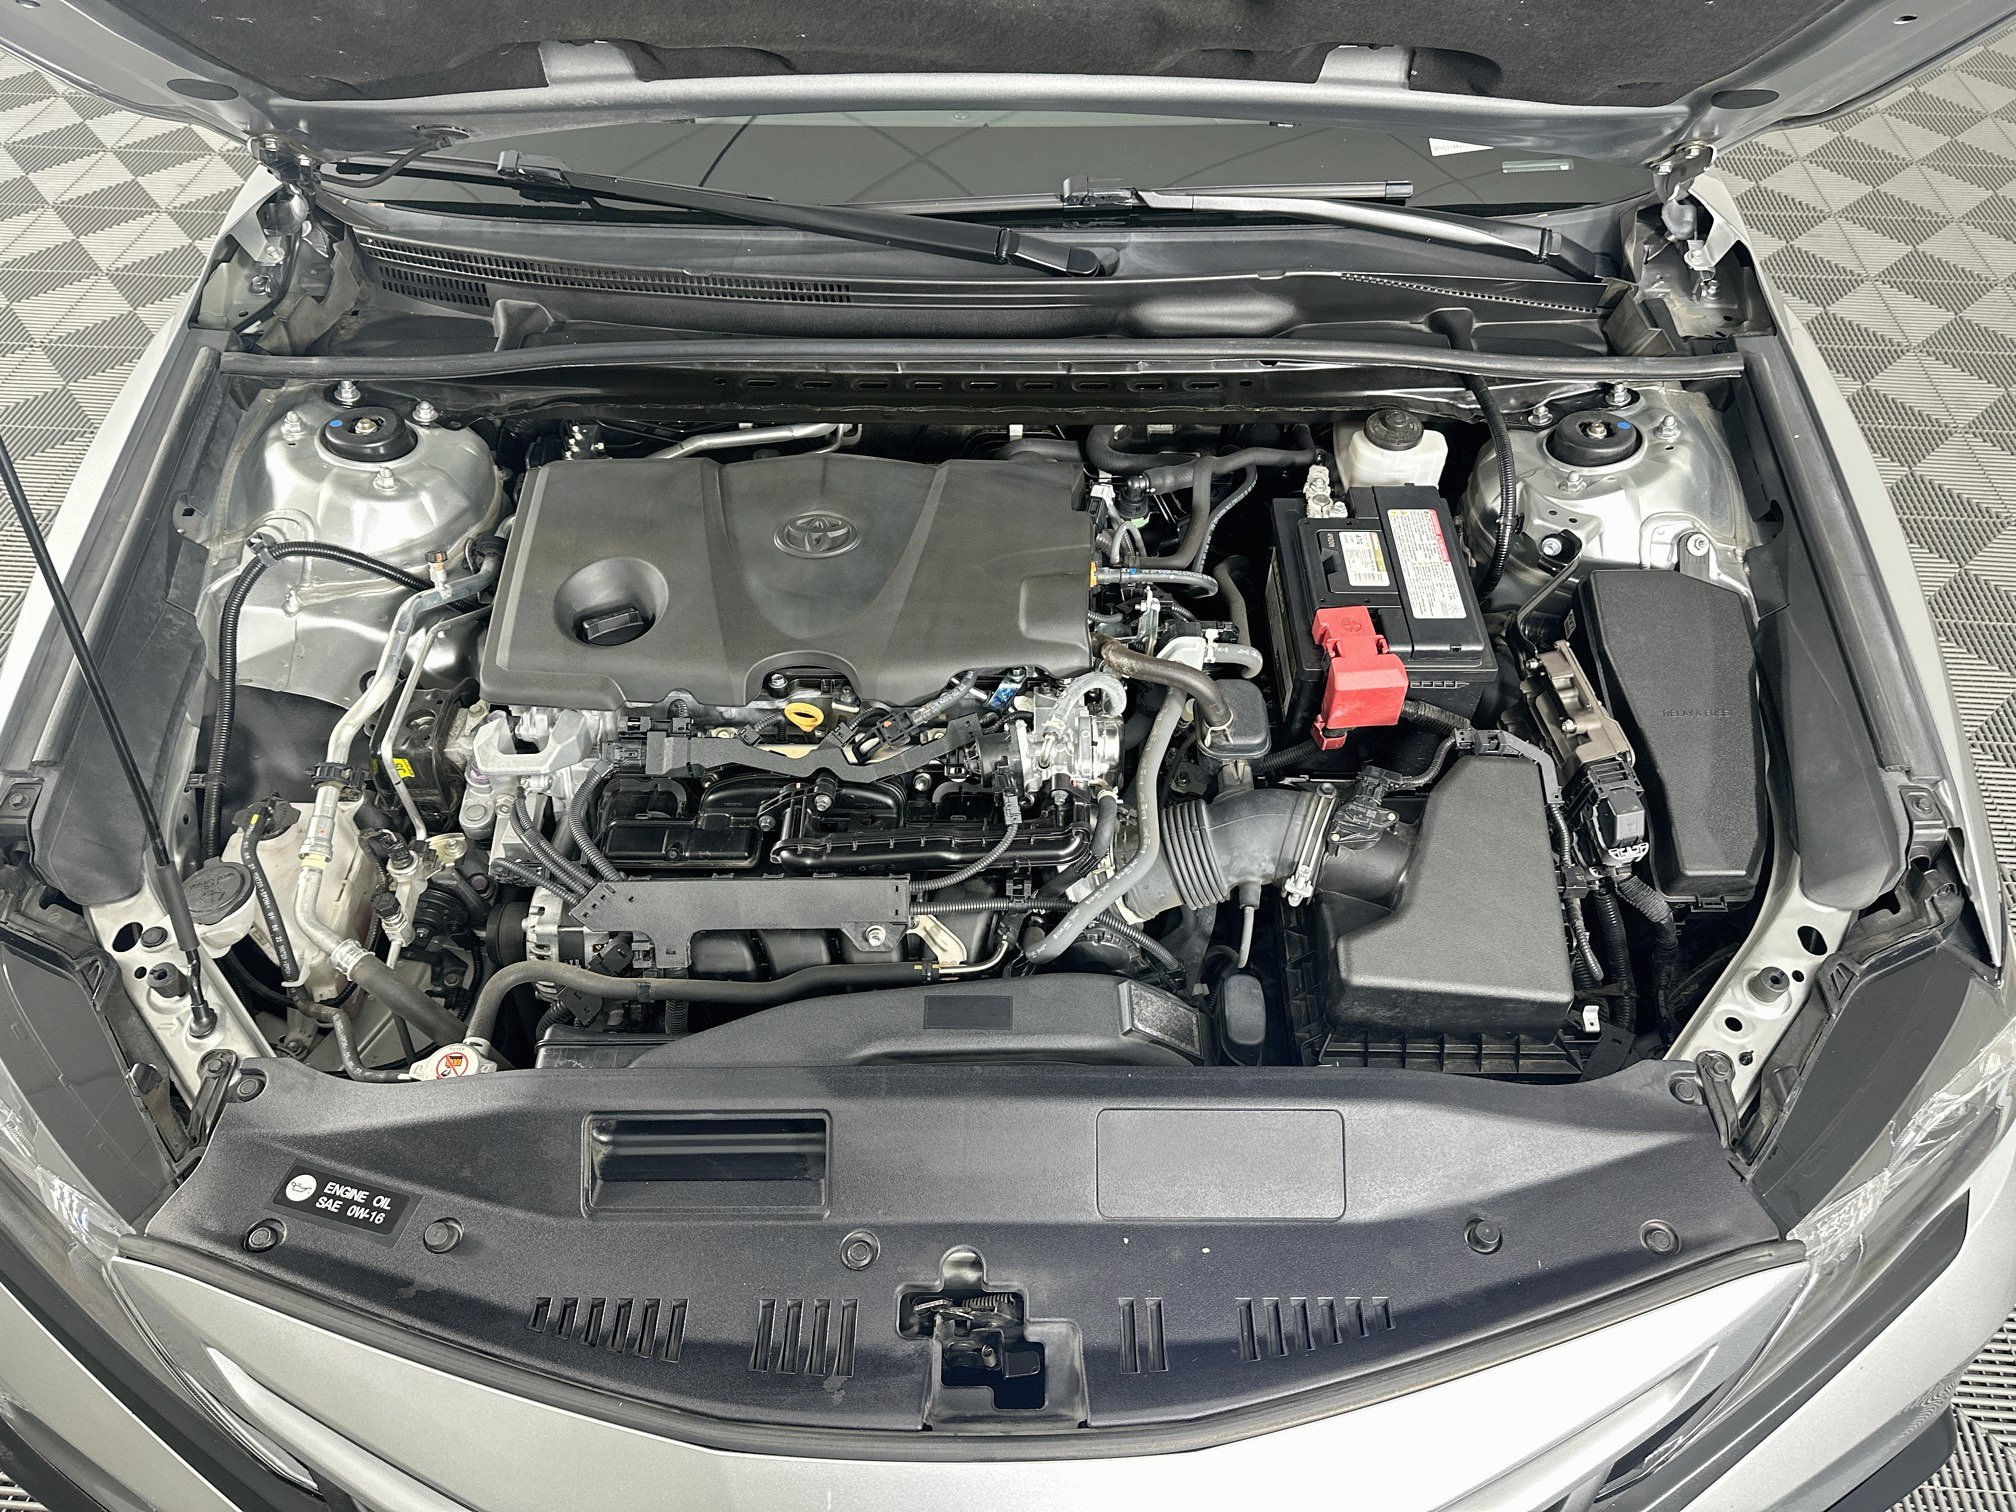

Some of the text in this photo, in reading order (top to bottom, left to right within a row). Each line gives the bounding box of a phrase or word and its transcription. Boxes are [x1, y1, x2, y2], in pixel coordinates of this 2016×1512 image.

[323, 1181, 391, 1210] ENGINE OIL
[315, 1196, 386, 1224] SAE 0W-16
